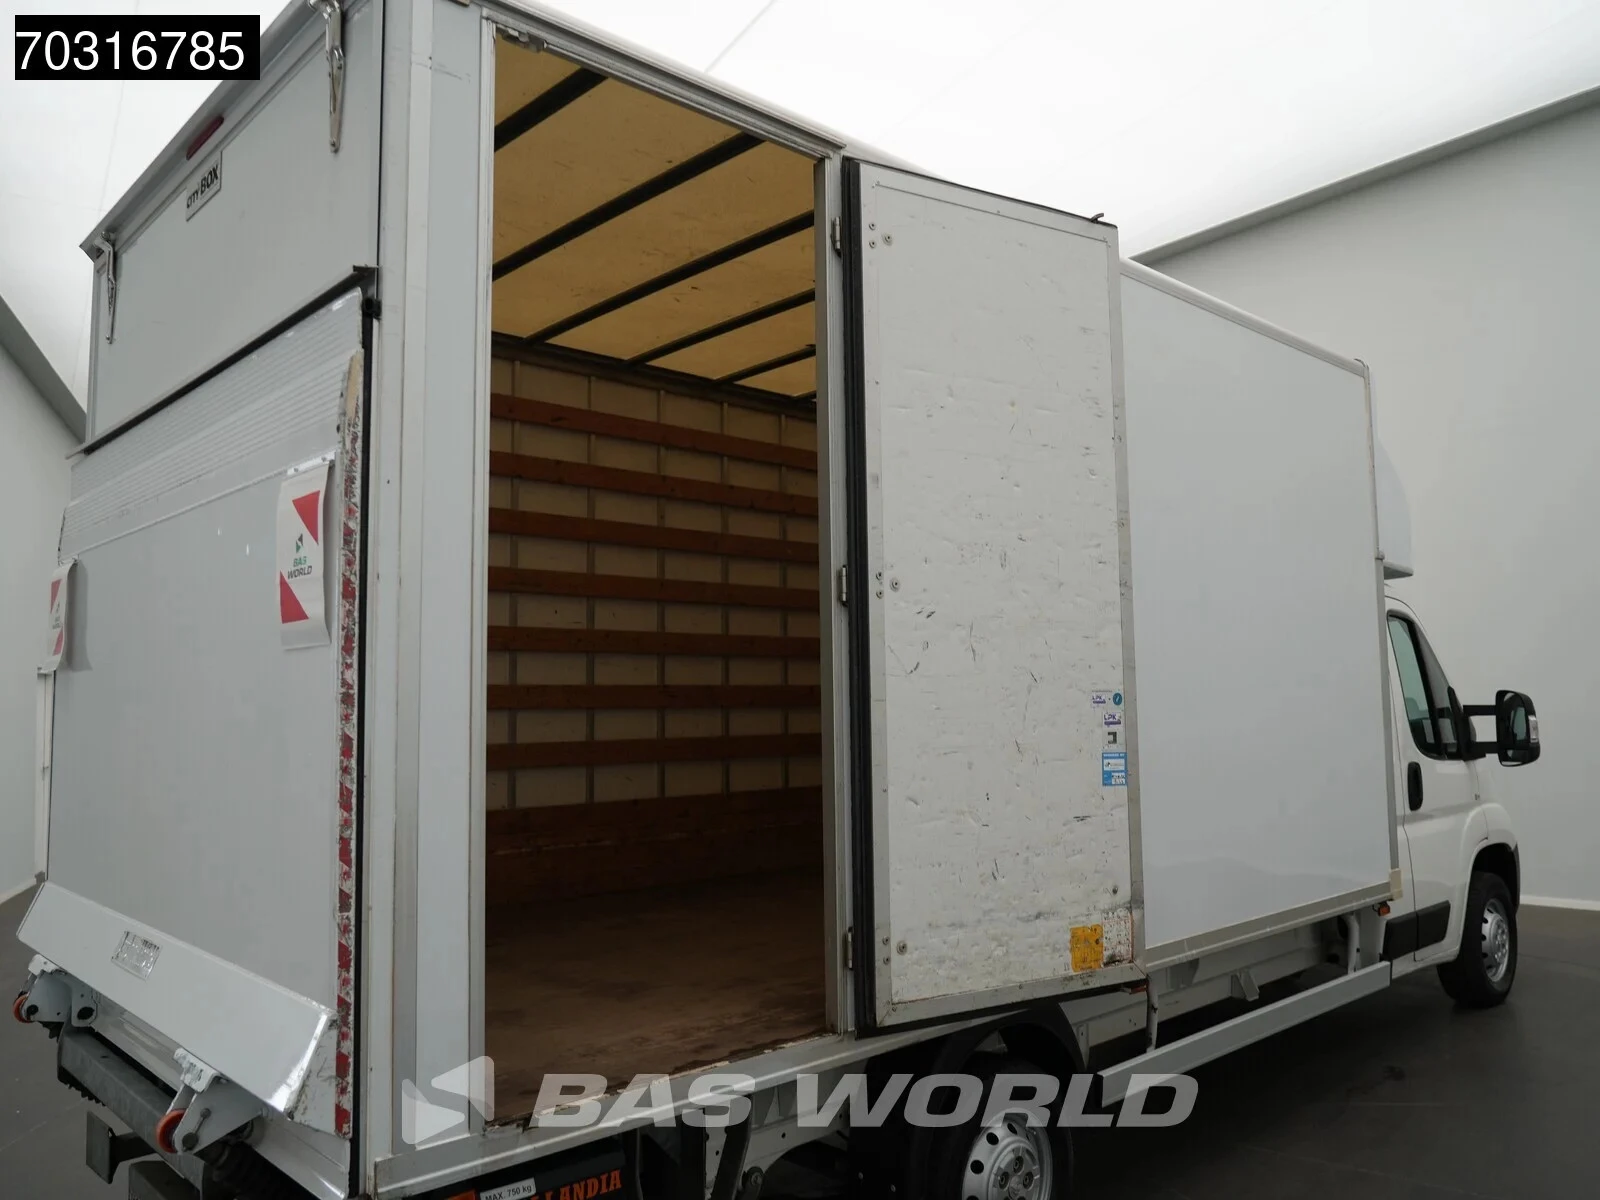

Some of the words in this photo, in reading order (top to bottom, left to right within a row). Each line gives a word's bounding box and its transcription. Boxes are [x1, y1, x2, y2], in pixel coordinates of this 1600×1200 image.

[200, 164, 219, 195] BOX
[293, 556, 307, 567] BAS
[288, 565, 312, 579] WORLD
[507, 1186, 521, 1197] 750
[522, 1185, 532, 1193] kg
